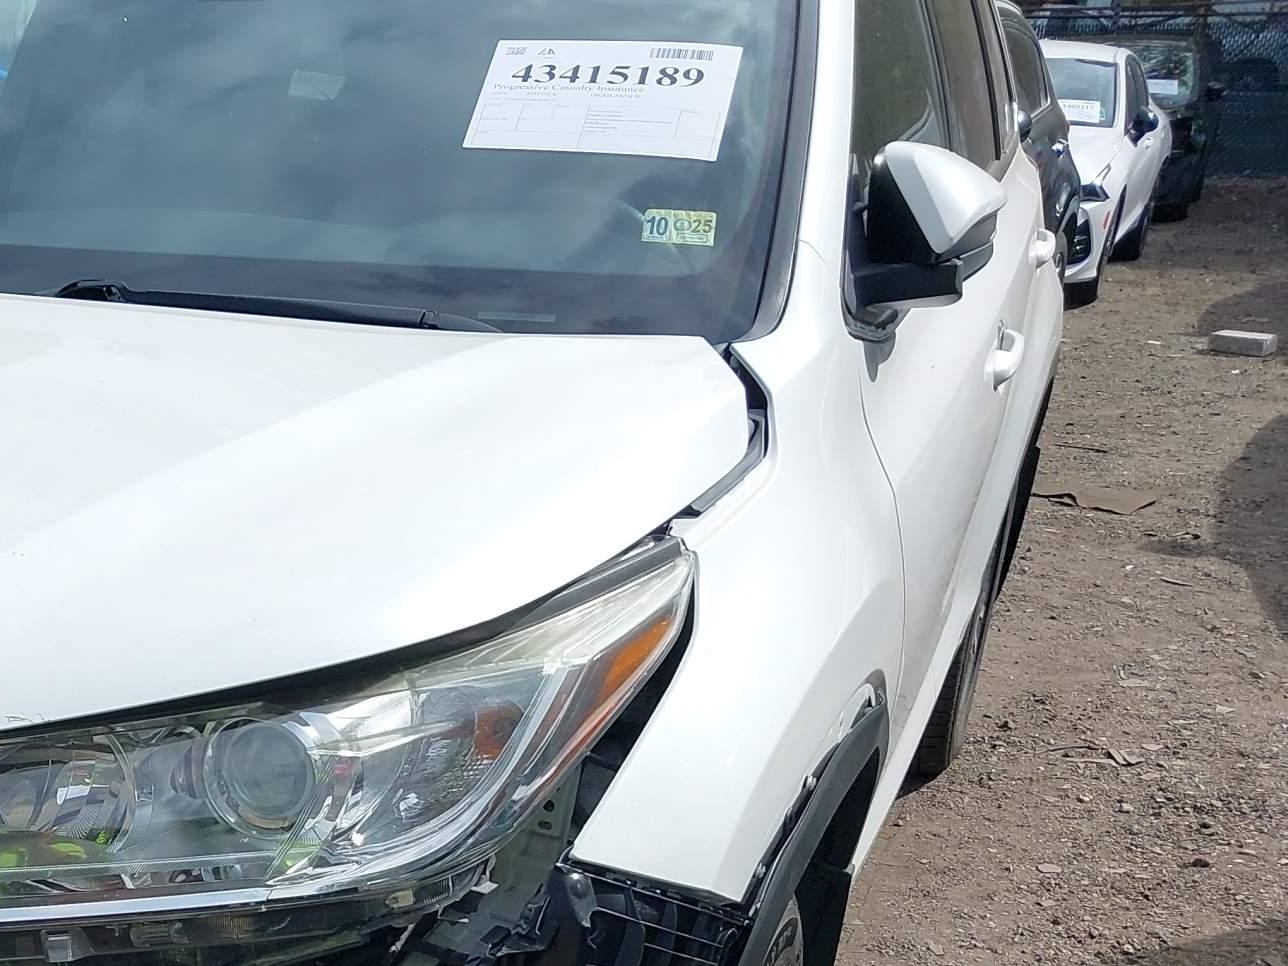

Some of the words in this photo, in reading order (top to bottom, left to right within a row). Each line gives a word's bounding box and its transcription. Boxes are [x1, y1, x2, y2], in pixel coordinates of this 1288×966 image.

[511, 63, 705, 88] 43415189
[493, 83, 547, 92] Progressive
[552, 84, 593, 93] Casualty
[597, 85, 646, 93] Insurance
[646, 215, 669, 236] 10
[690, 218, 713, 234] 25
